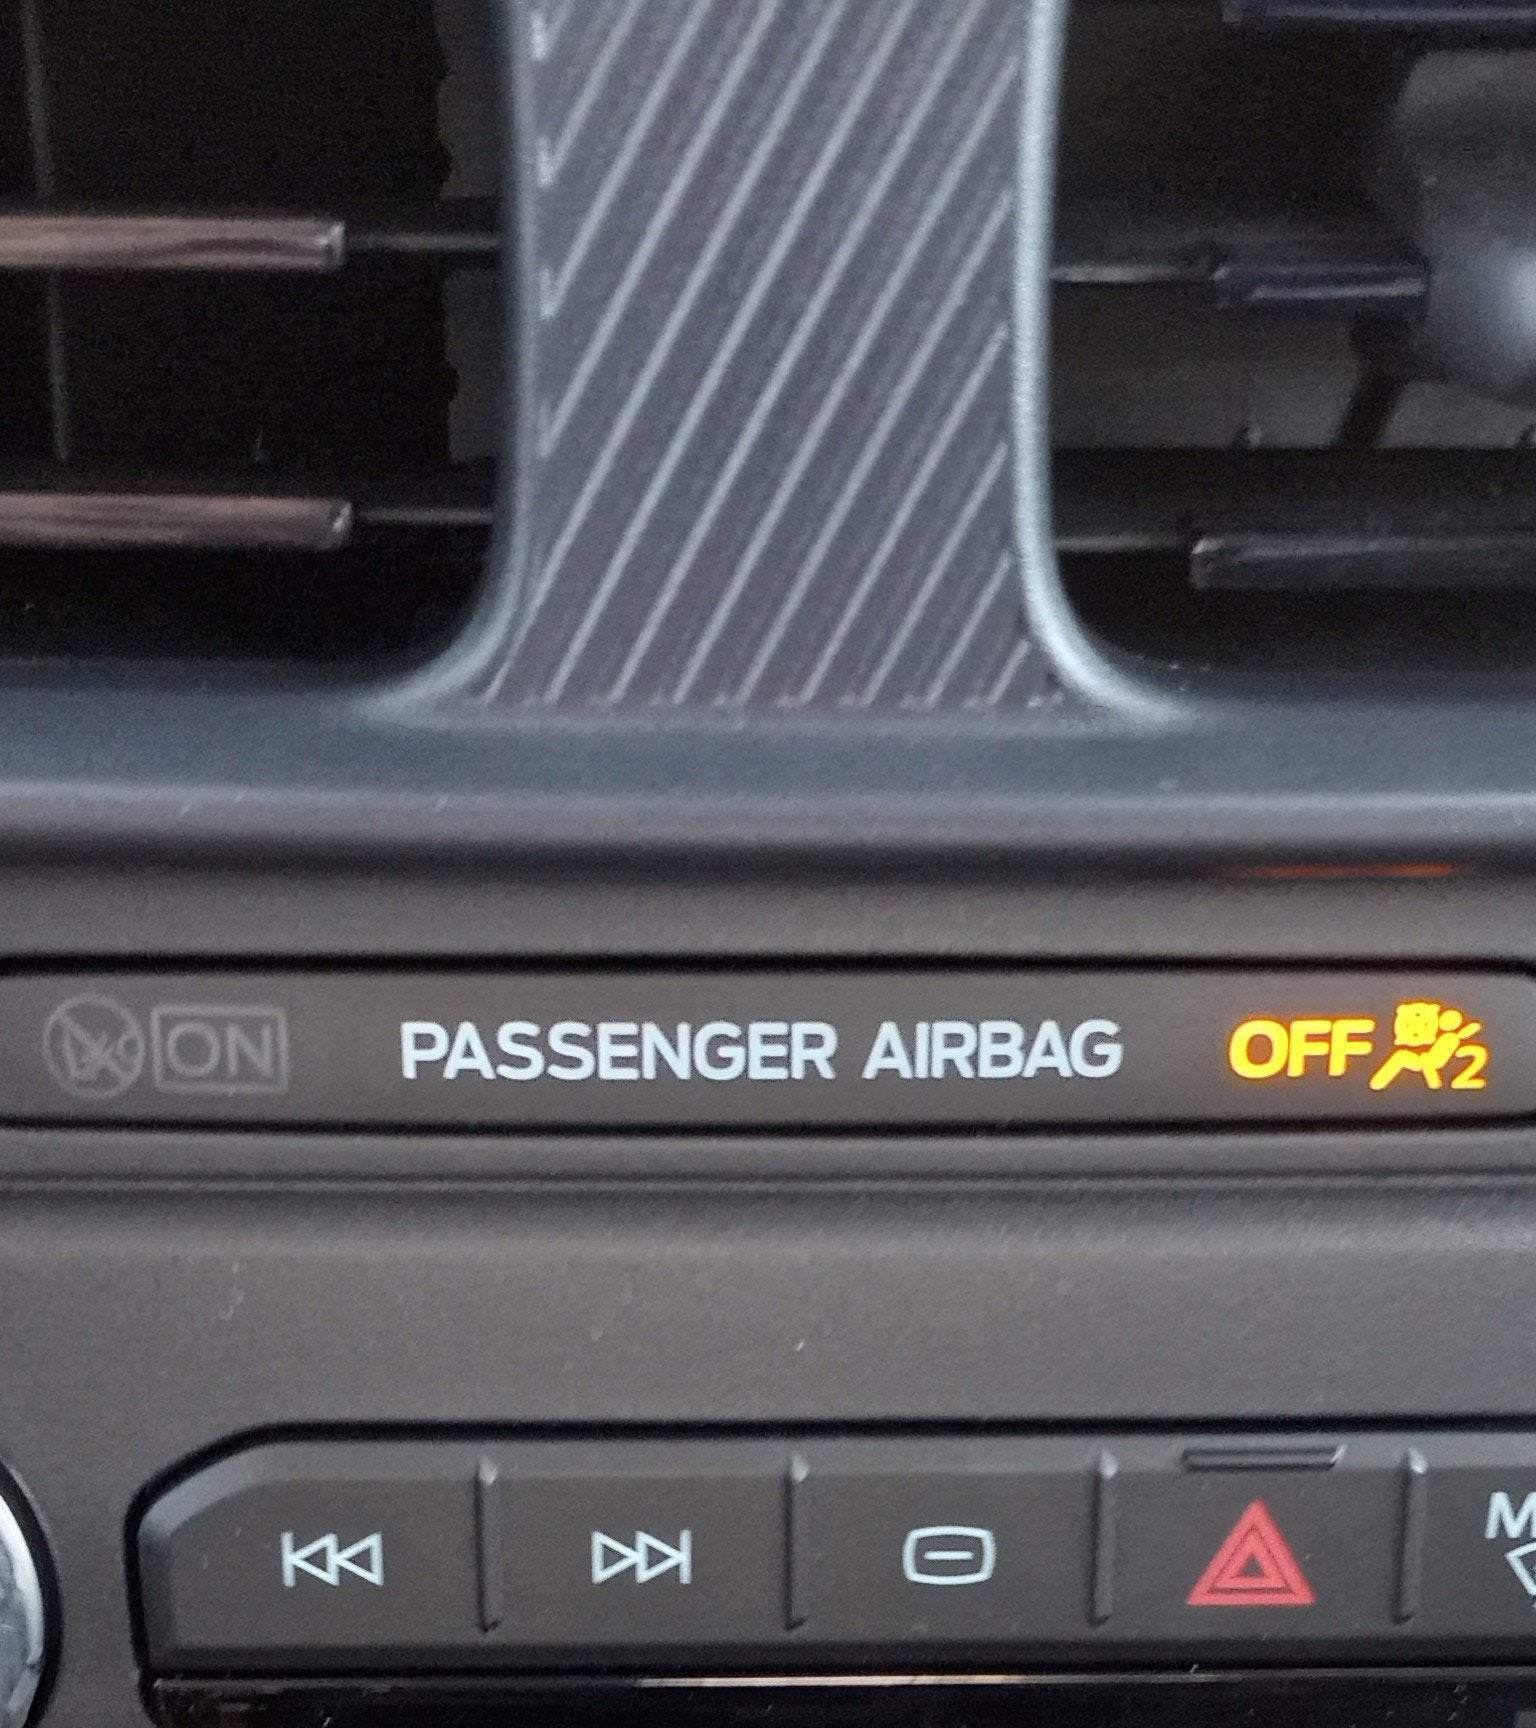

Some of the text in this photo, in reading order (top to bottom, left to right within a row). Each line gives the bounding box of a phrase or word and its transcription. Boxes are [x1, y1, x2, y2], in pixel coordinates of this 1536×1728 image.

[167, 1018, 1488, 1090] ON PASSENGER AIRBAG OFF 2
